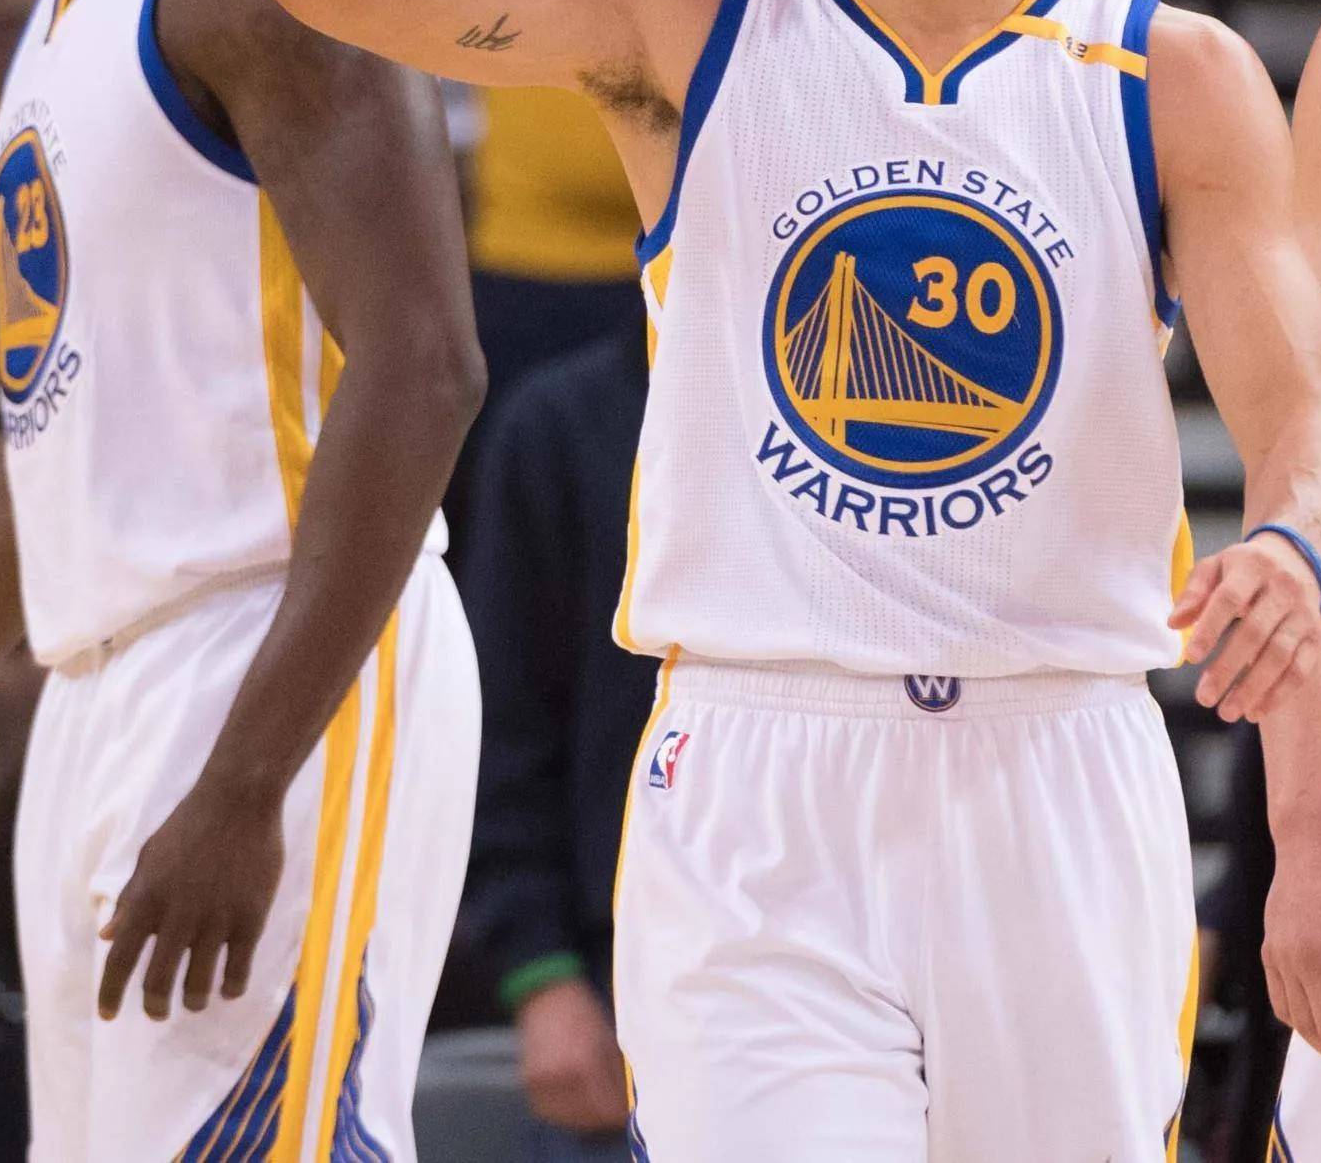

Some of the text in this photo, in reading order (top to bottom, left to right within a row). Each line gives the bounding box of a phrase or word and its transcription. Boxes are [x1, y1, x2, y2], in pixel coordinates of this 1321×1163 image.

[16, 178, 49, 253] 23
[772, 159, 1075, 269] GOLDEN STATE
[906, 255, 1017, 335] 30
[4, 341, 82, 452] RRIORS
[755, 420, 1054, 538] WARRIORS
[912, 675, 952, 700] W
